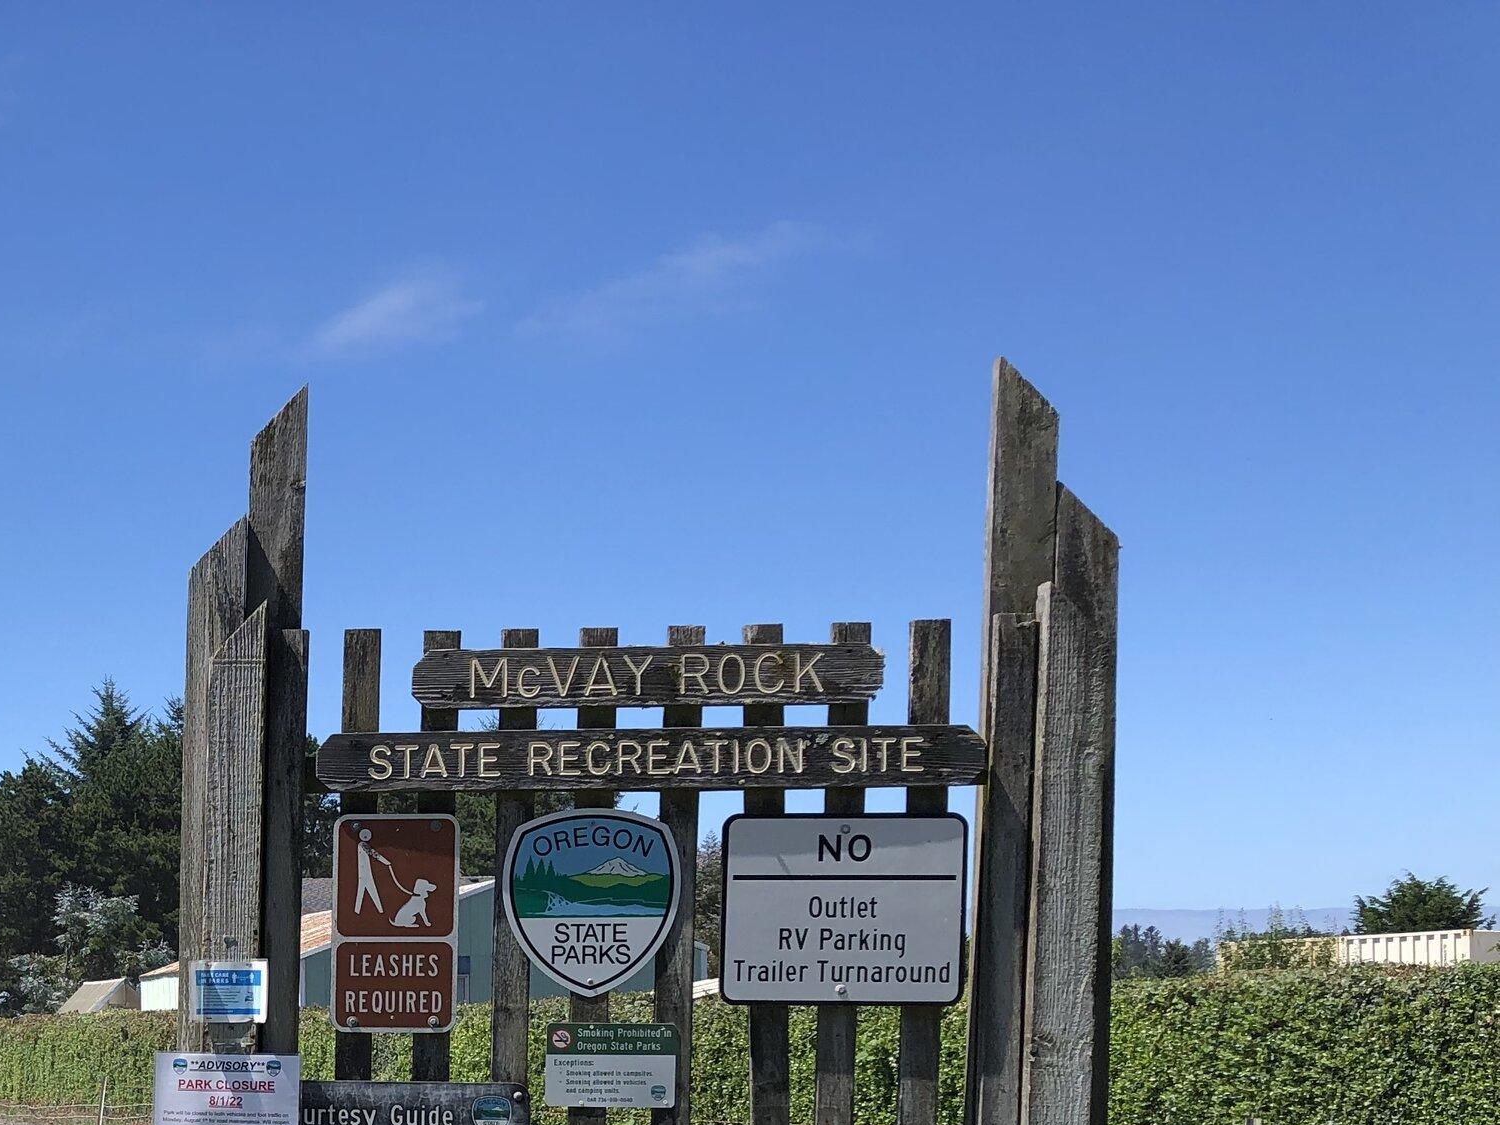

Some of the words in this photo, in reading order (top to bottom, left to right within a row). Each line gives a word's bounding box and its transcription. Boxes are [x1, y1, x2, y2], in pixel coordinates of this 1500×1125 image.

[680, 652, 825, 695] ROCK
[369, 741, 500, 779] STATE
[528, 738, 804, 776] RECREATION
[831, 737, 924, 774] SITE
[532, 826, 654, 858] OREGON
[818, 835, 872, 862] NO
[809, 896, 877, 919] Outlet
[554, 923, 627, 944] STATE
[779, 930, 809, 950] RV
[817, 930, 906, 958] Parking
[350, 955, 439, 977] LEASHES
[551, 944, 632, 966] PARKS
[734, 960, 807, 983] Trailer
[817, 961, 950, 984] Turnaround
[345, 991, 442, 1014] REQUIRED
[577, 1029, 614, 1039] Smoking
[618, 1029, 660, 1037] Prohibited
[577, 1042, 607, 1052] Oregon
[611, 1042, 633, 1050] State
[554, 1059, 594, 1067] Exceptions:
[178, 1079, 211, 1089] PARK
[216, 1080, 275, 1091] CLOSURE
[209, 1096, 242, 1106] 8/1/22
